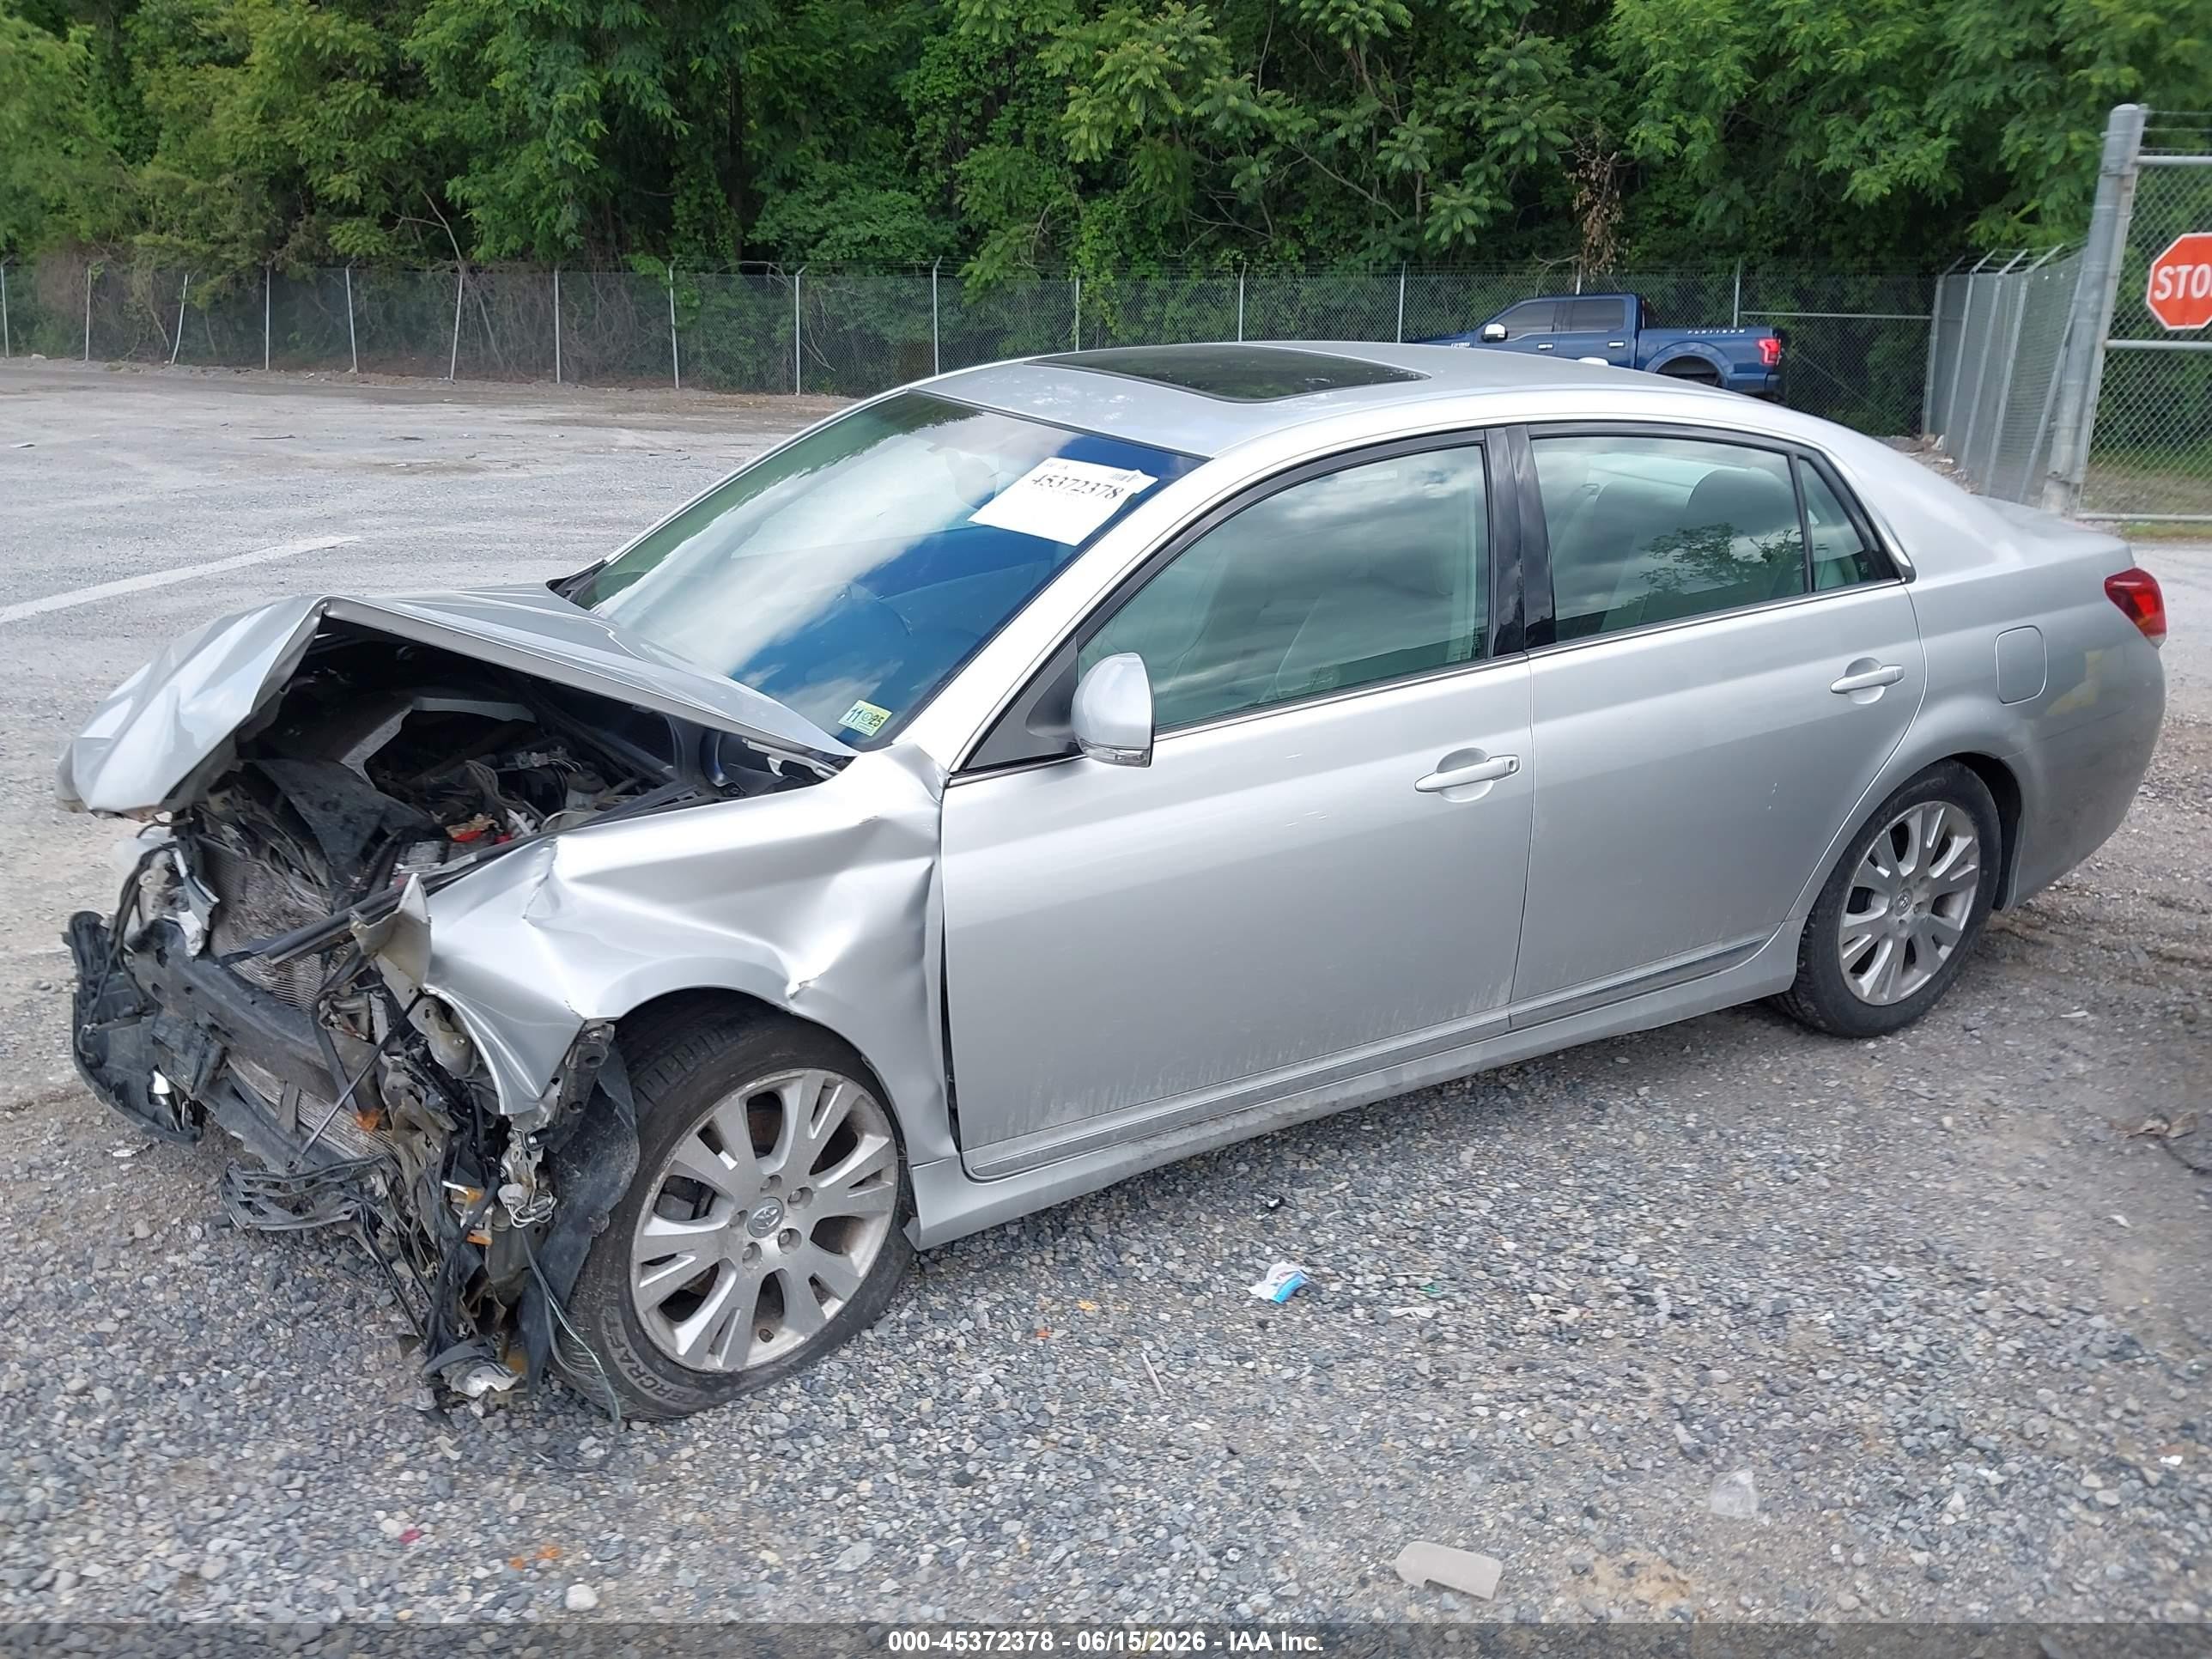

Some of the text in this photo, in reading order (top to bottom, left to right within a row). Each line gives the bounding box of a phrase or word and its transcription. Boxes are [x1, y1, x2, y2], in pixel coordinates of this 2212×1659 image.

[2154, 263, 2212, 301] STO
[1031, 474, 1125, 500] 45372378
[846, 708, 864, 723] 11
